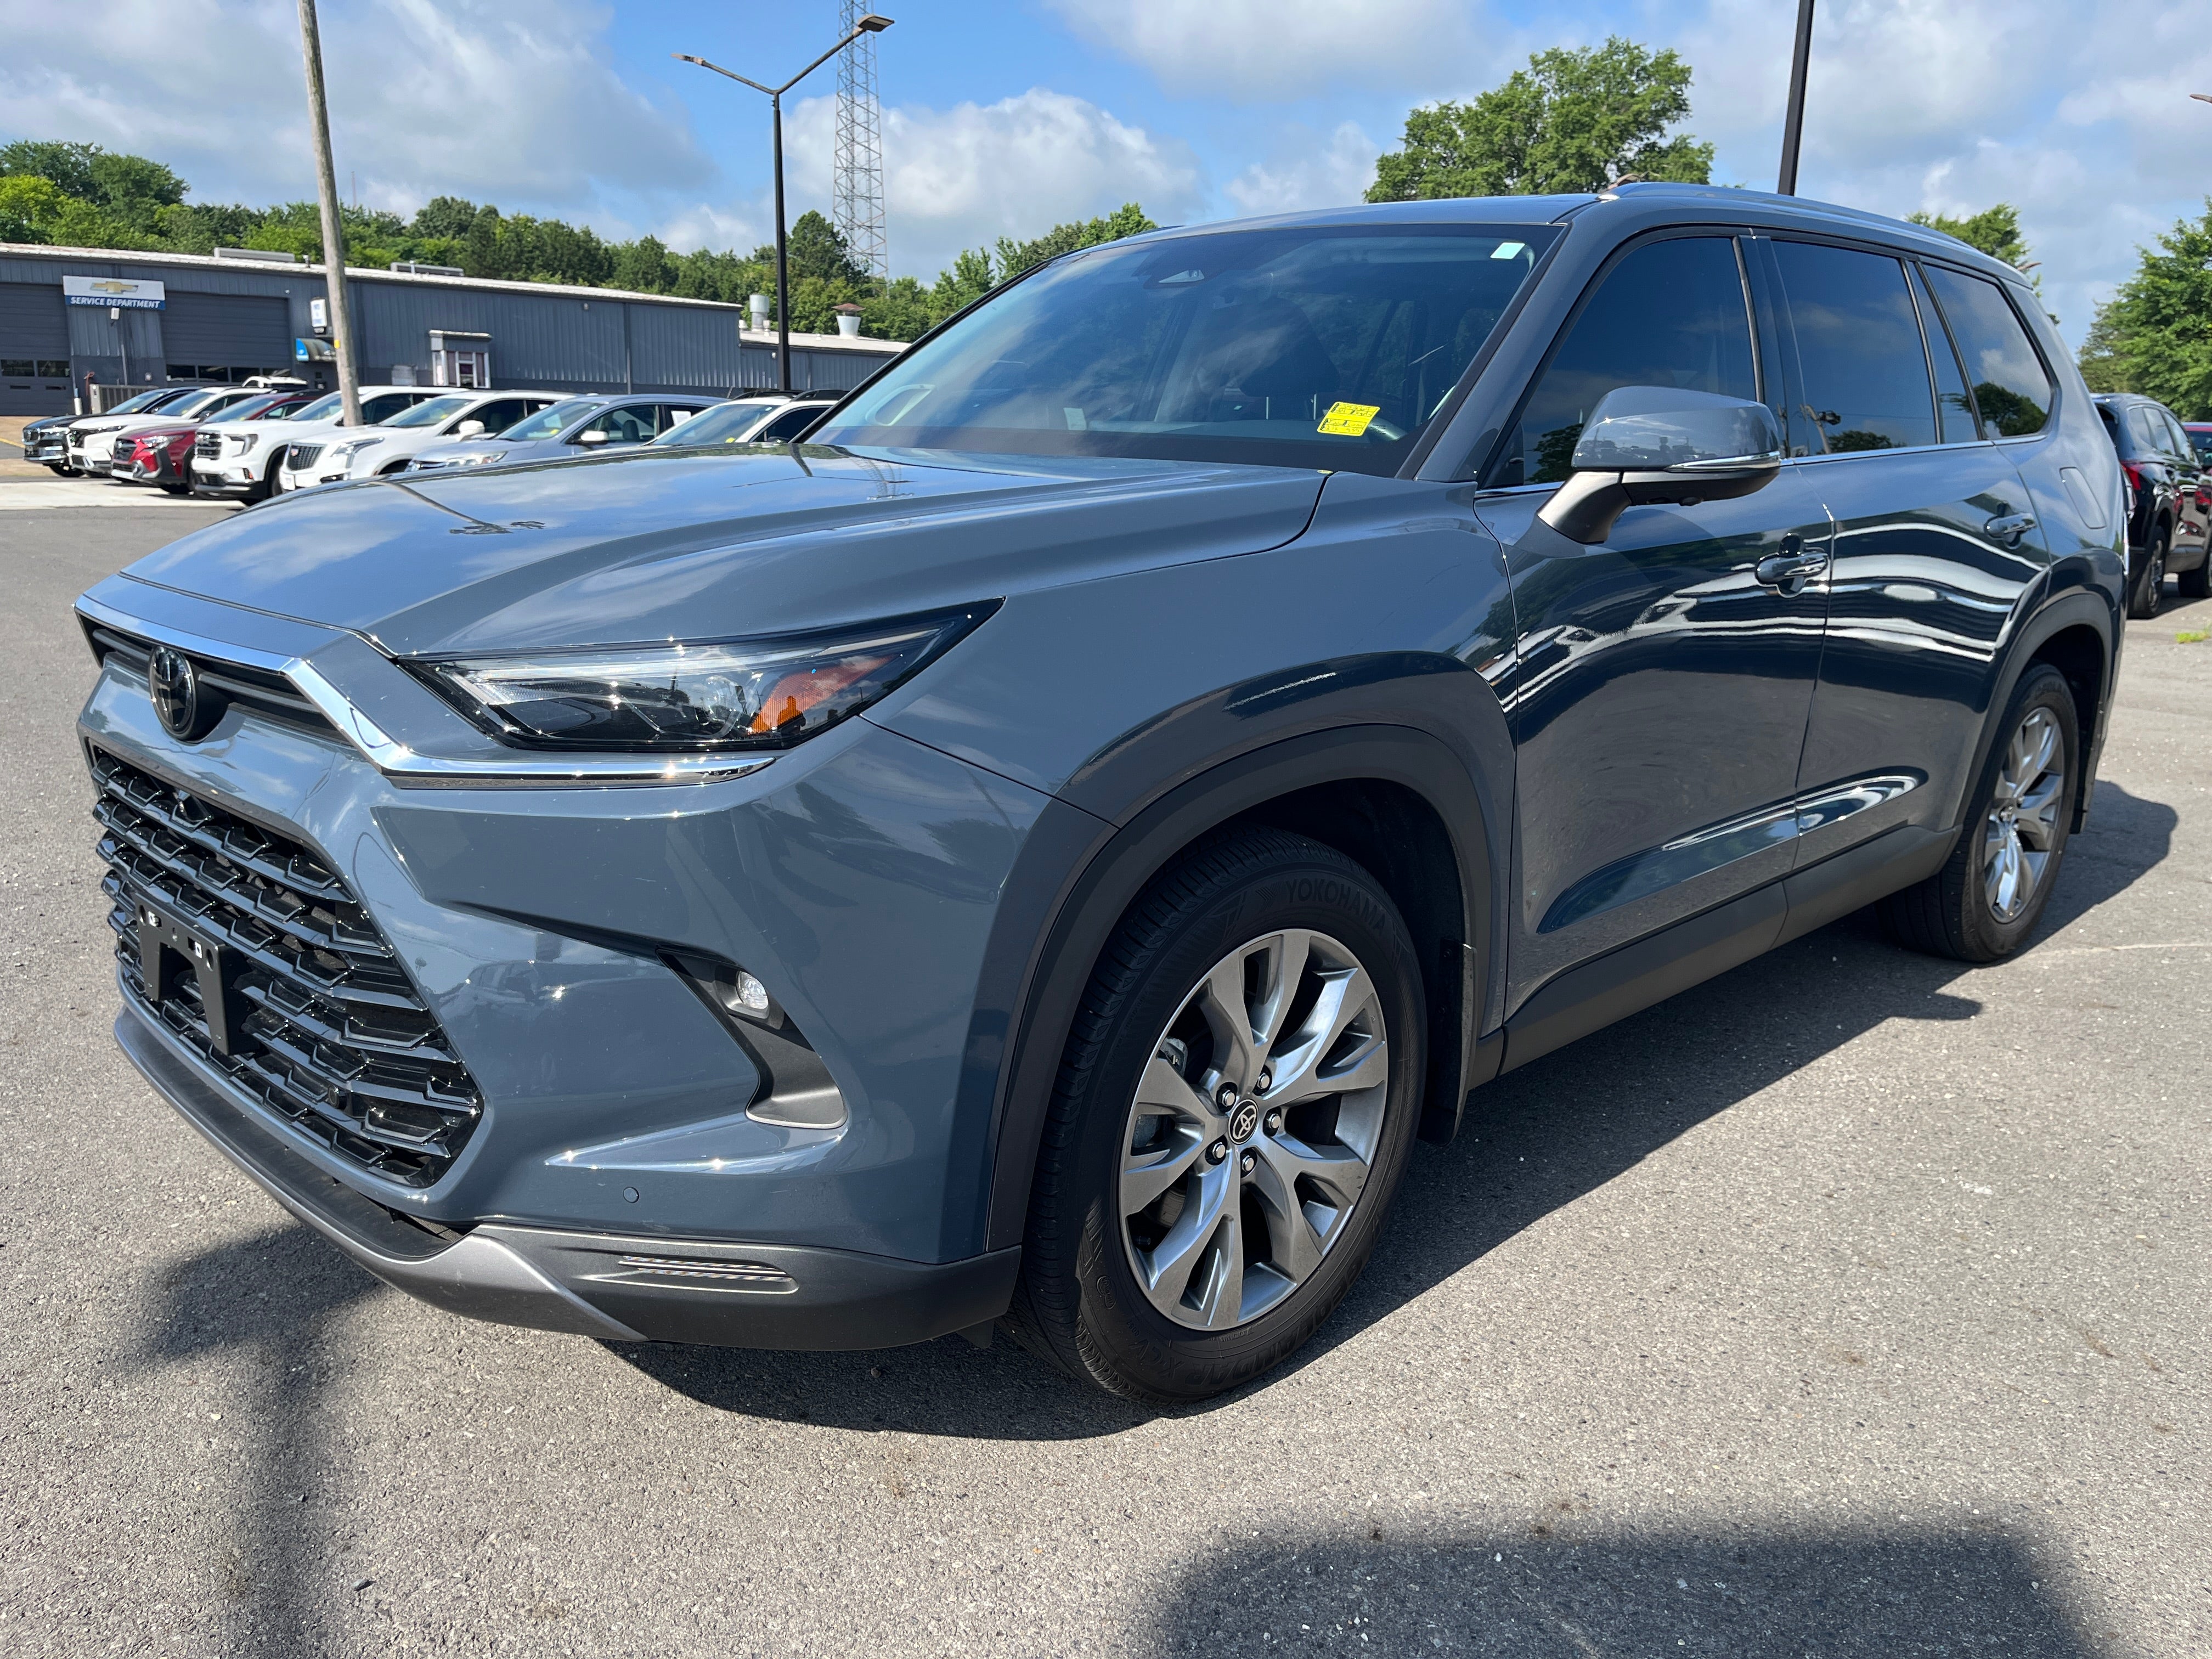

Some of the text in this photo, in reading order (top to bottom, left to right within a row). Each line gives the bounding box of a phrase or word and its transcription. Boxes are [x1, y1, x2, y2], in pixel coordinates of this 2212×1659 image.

[71, 297, 160, 308] SERVICE DEPARTMENT
[1285, 878, 1386, 930] YOKOHAMA
[1185, 1255, 1363, 1386] GEOLANDAR
